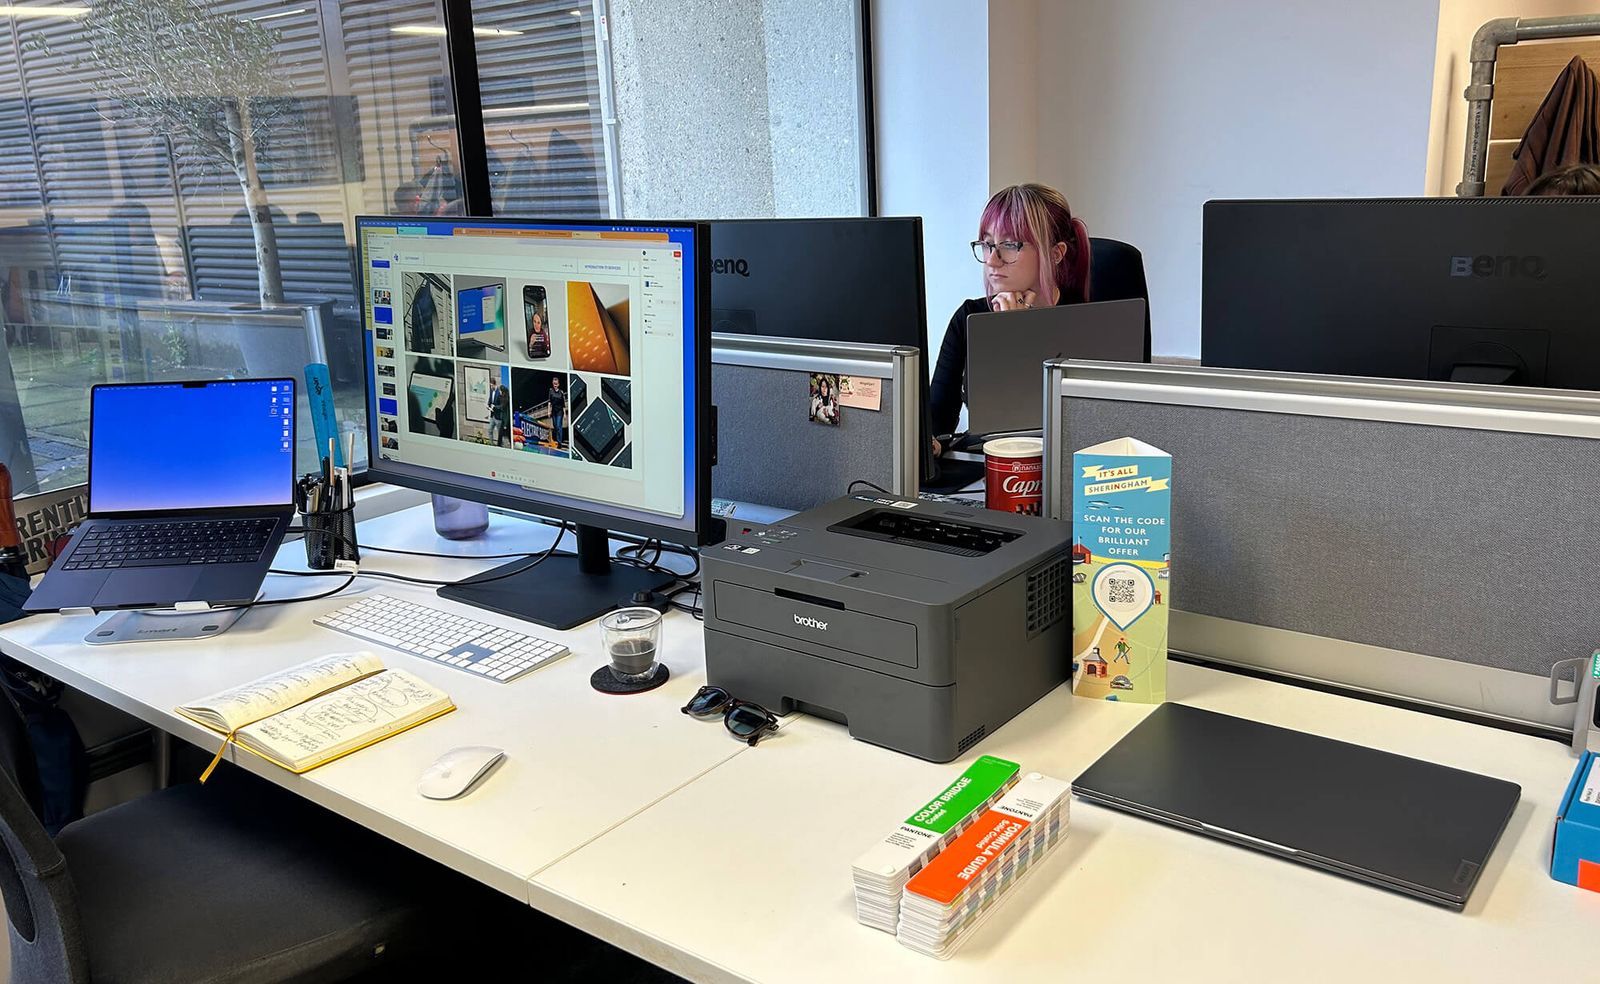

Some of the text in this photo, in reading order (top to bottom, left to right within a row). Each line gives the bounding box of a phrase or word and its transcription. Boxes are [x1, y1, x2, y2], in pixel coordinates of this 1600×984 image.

[711, 258, 750, 277] enQ
[1450, 254, 1549, 281] BenQ
[1099, 467, 1133, 478] IT'S ALL
[1088, 479, 1148, 494] SHERINGHAM
[1084, 514, 1166, 526] SCAN THE CODE
[1102, 526, 1146, 535] FOR OUR
[1098, 536, 1150, 546] BRILLIANT
[1108, 547, 1139, 556] OFFER
[793, 613, 828, 631] brother
[914, 776, 972, 822] COLOR BRIDGE
[1000, 805, 1033, 818] PANTONE
[900, 826, 932, 839] PANTONE
[957, 822, 1022, 880] FORMULA GUIDE
